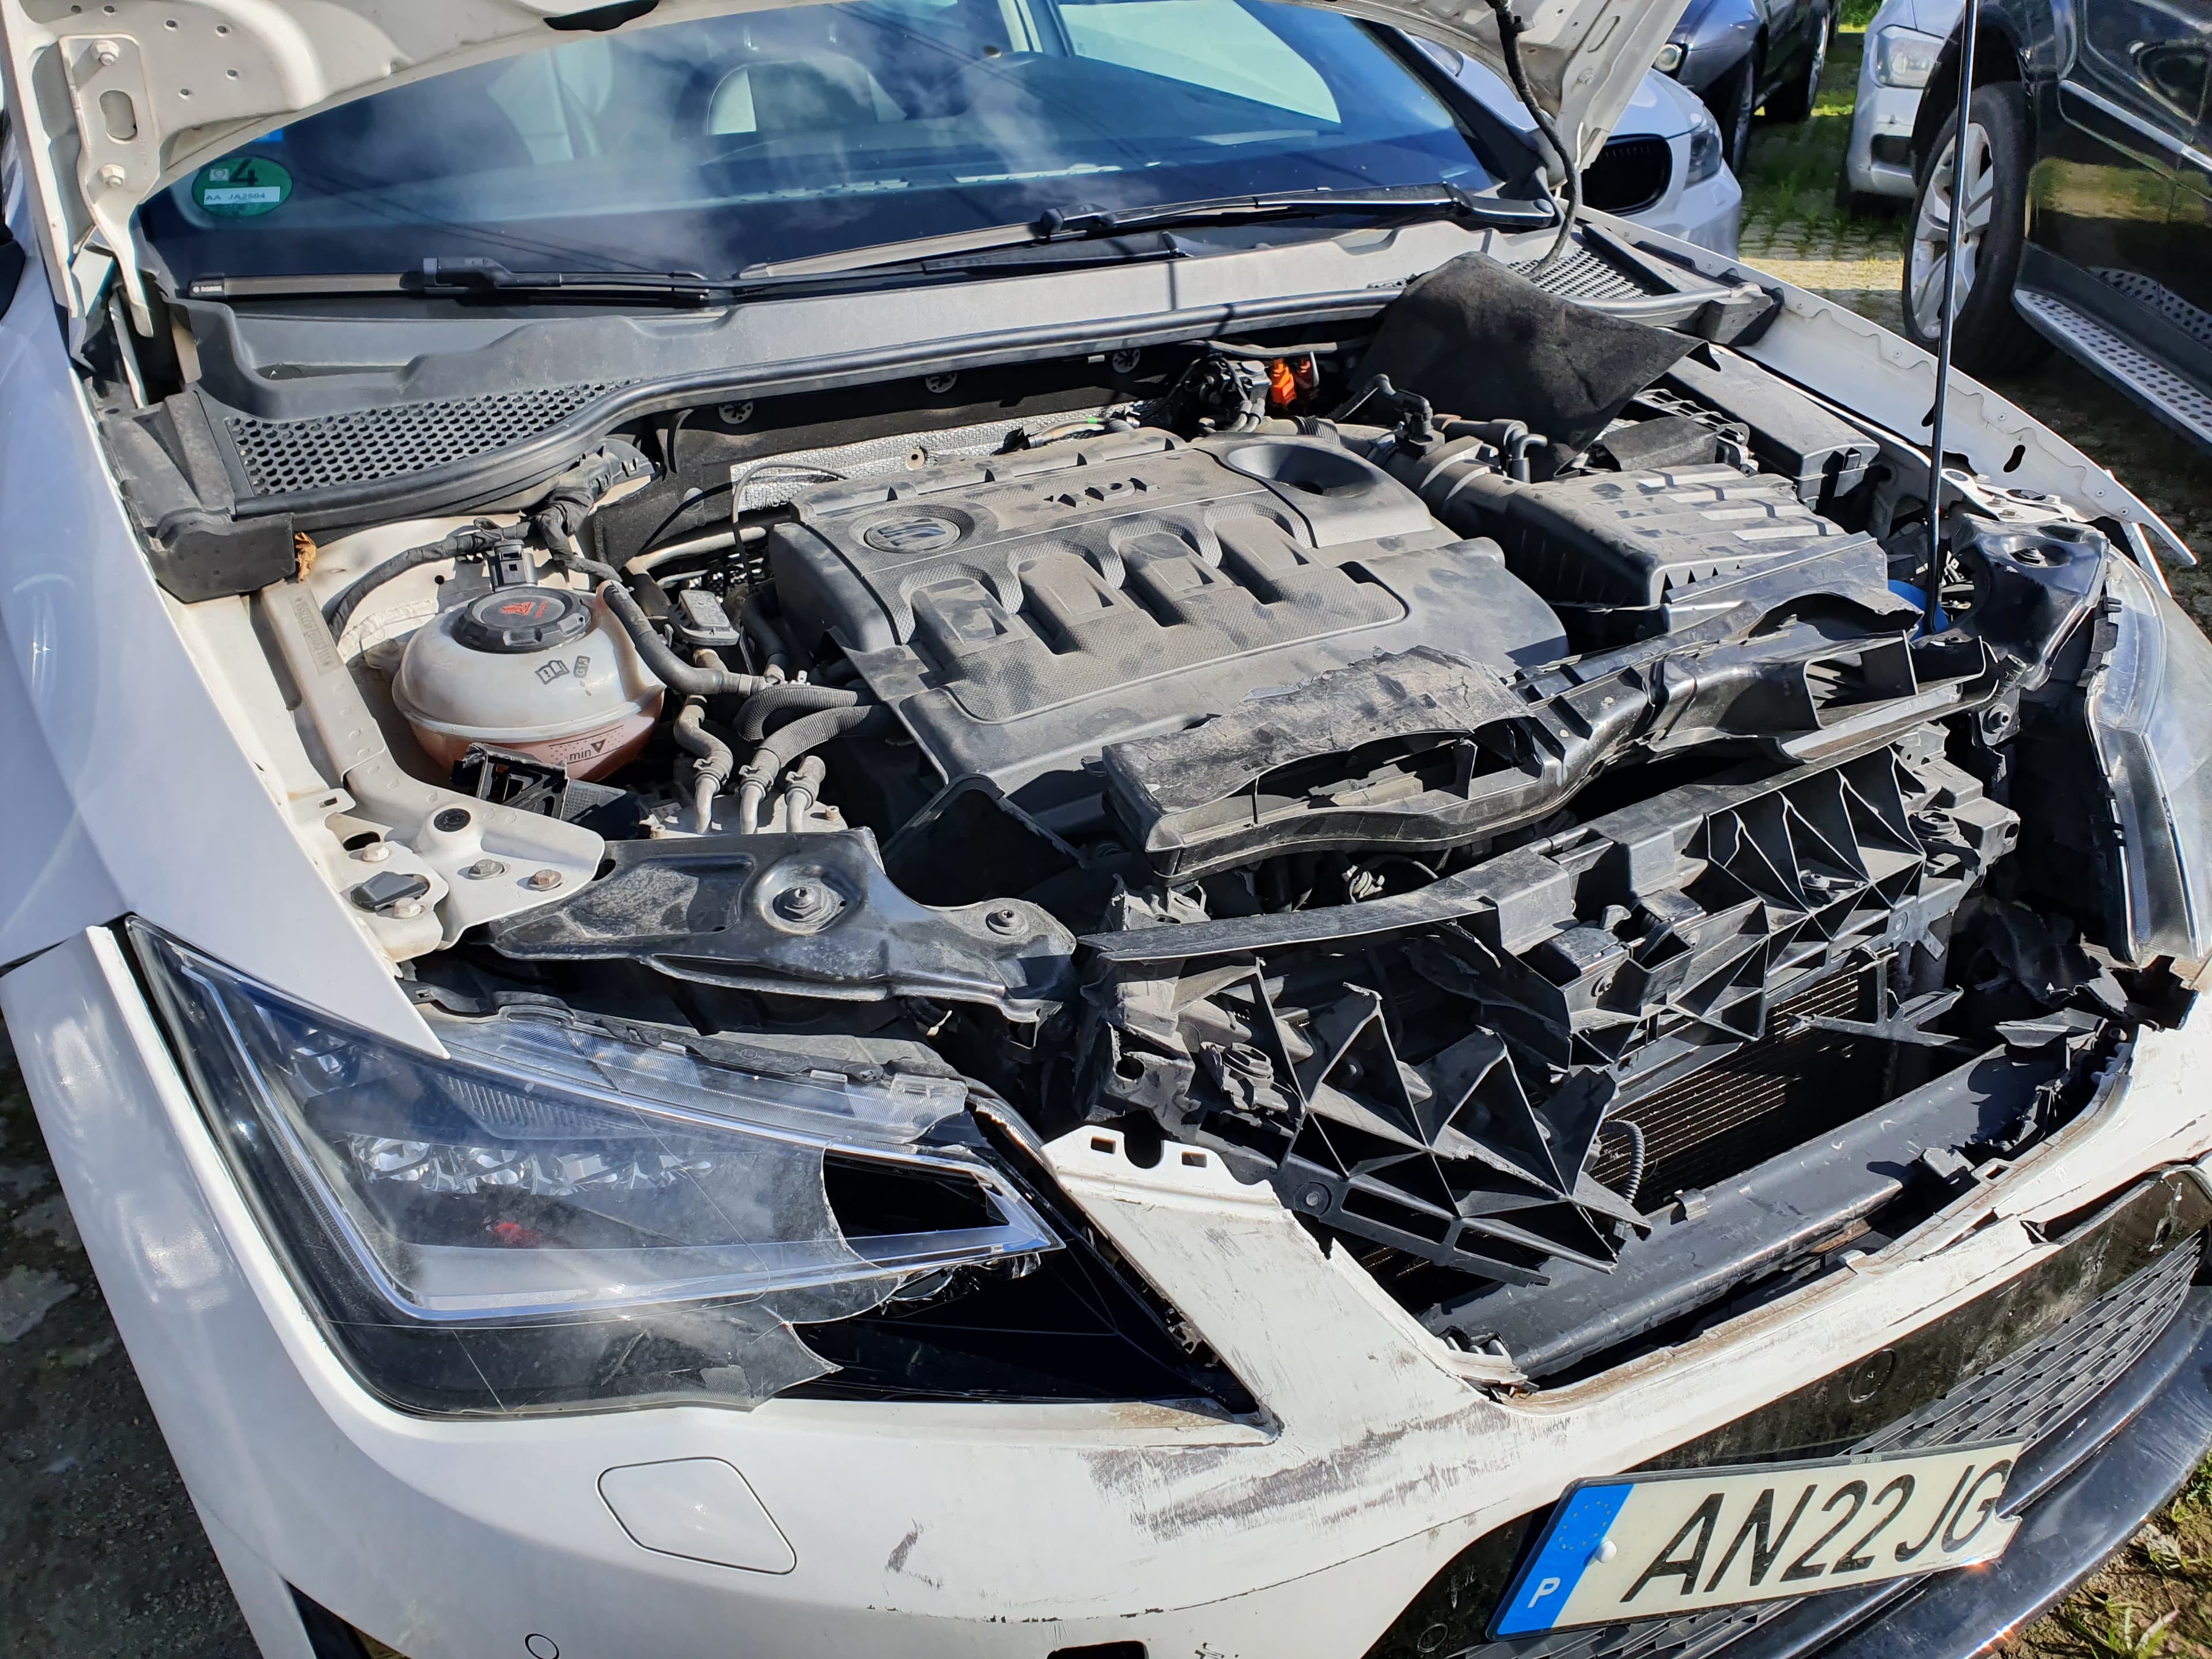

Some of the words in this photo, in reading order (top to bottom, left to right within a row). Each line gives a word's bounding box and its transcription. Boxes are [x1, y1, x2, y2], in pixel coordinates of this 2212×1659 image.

[230, 158, 258, 186] 4
[576, 658, 588, 676] G13
[570, 748, 592, 761] min
[1527, 1577, 1561, 1608] P
